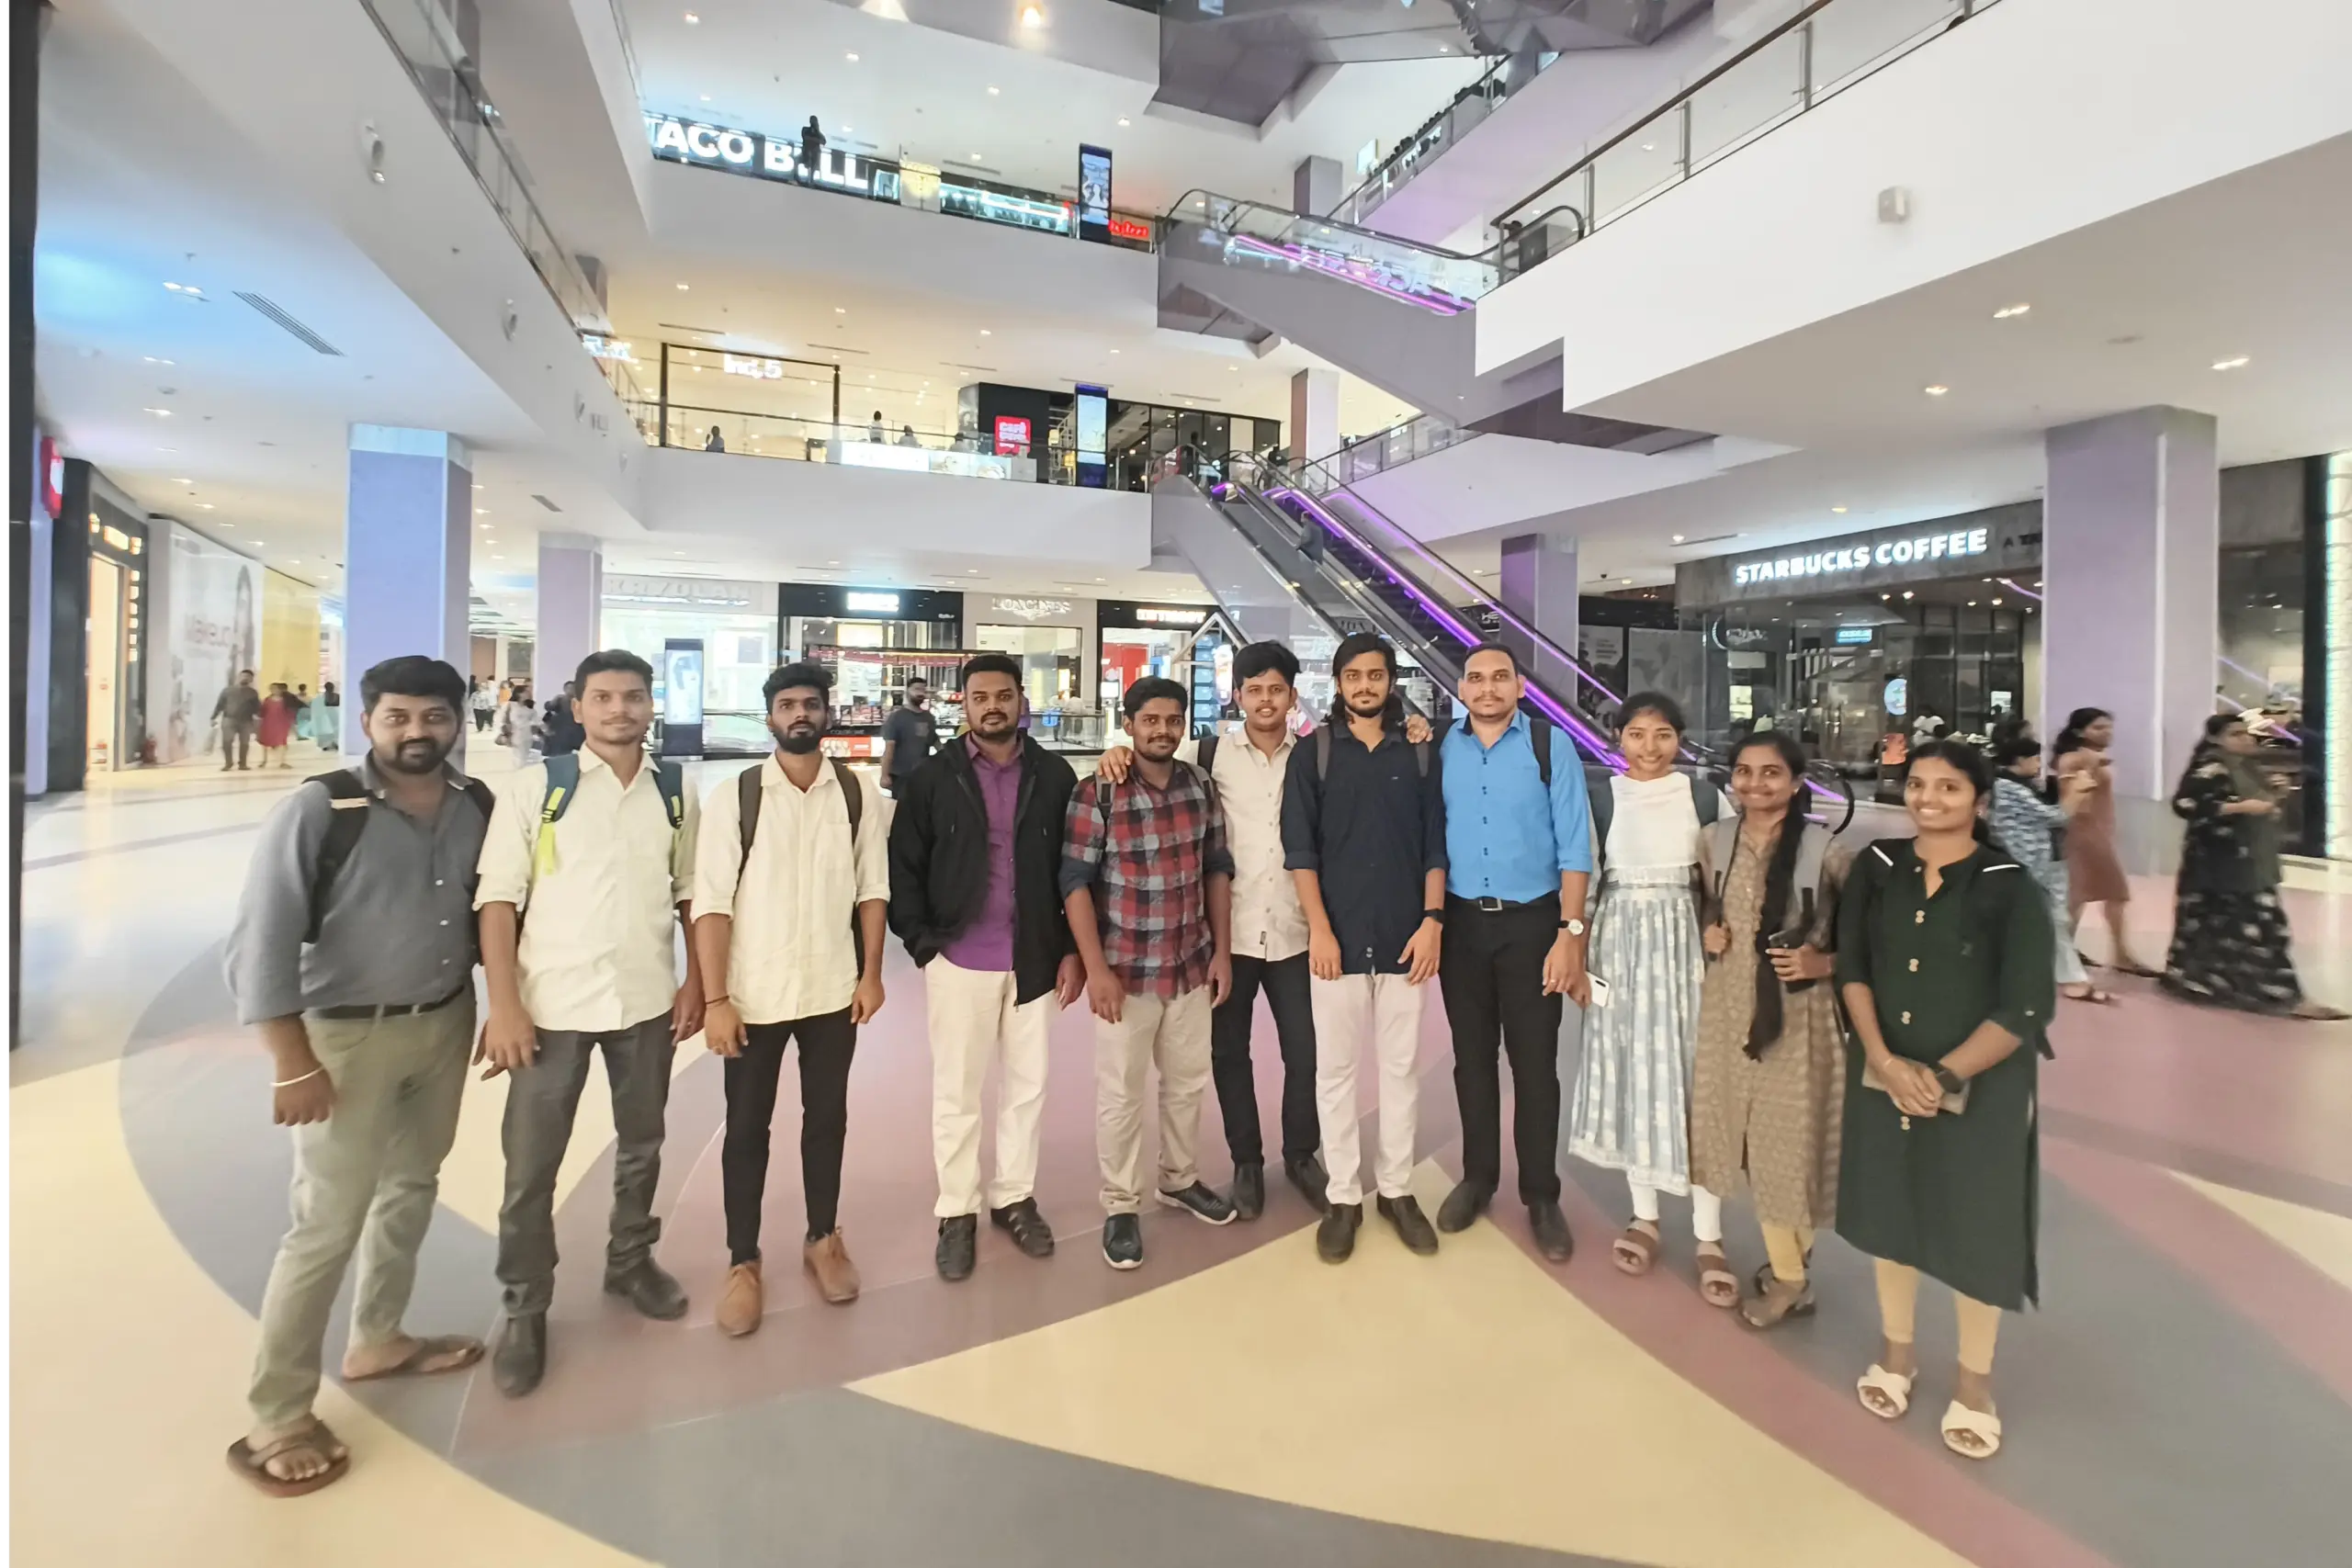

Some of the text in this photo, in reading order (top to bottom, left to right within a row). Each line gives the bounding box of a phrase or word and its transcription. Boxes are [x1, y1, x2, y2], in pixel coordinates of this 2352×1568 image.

[643, 117, 755, 164] TACO
[1735, 528, 1988, 585] STARBUCKS COFFEE
